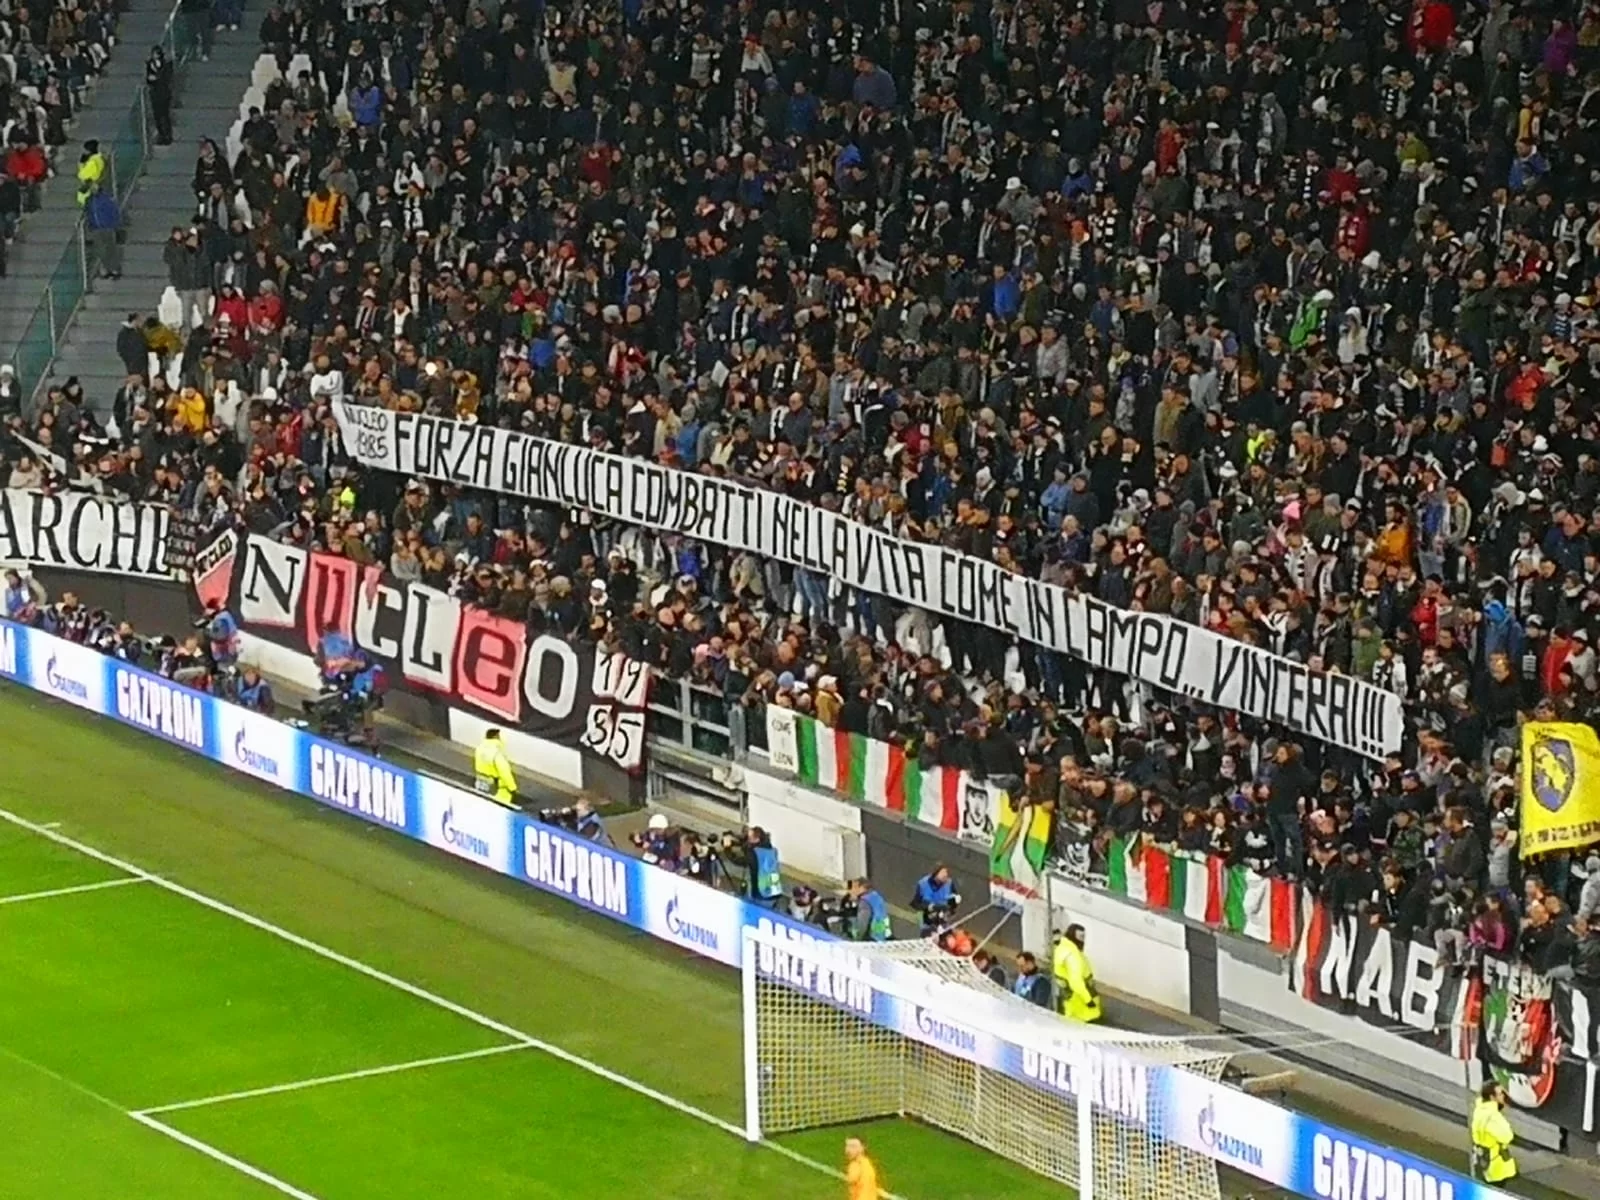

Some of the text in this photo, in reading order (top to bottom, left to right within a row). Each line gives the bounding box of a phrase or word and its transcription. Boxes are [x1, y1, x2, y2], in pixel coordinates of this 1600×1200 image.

[395, 413, 495, 486] FORZA
[502, 433, 623, 515] GIANLUCA
[631, 464, 762, 550] COMBATTI
[773, 496, 848, 579] NELLA
[856, 527, 926, 601] VITA
[941, 552, 1018, 633] COME
[1025, 581, 1056, 647] IN
[116, 669, 204, 748] GAZPROM
[310, 744, 406, 828] GAZPROM
[524, 825, 627, 915] GAZPROM
